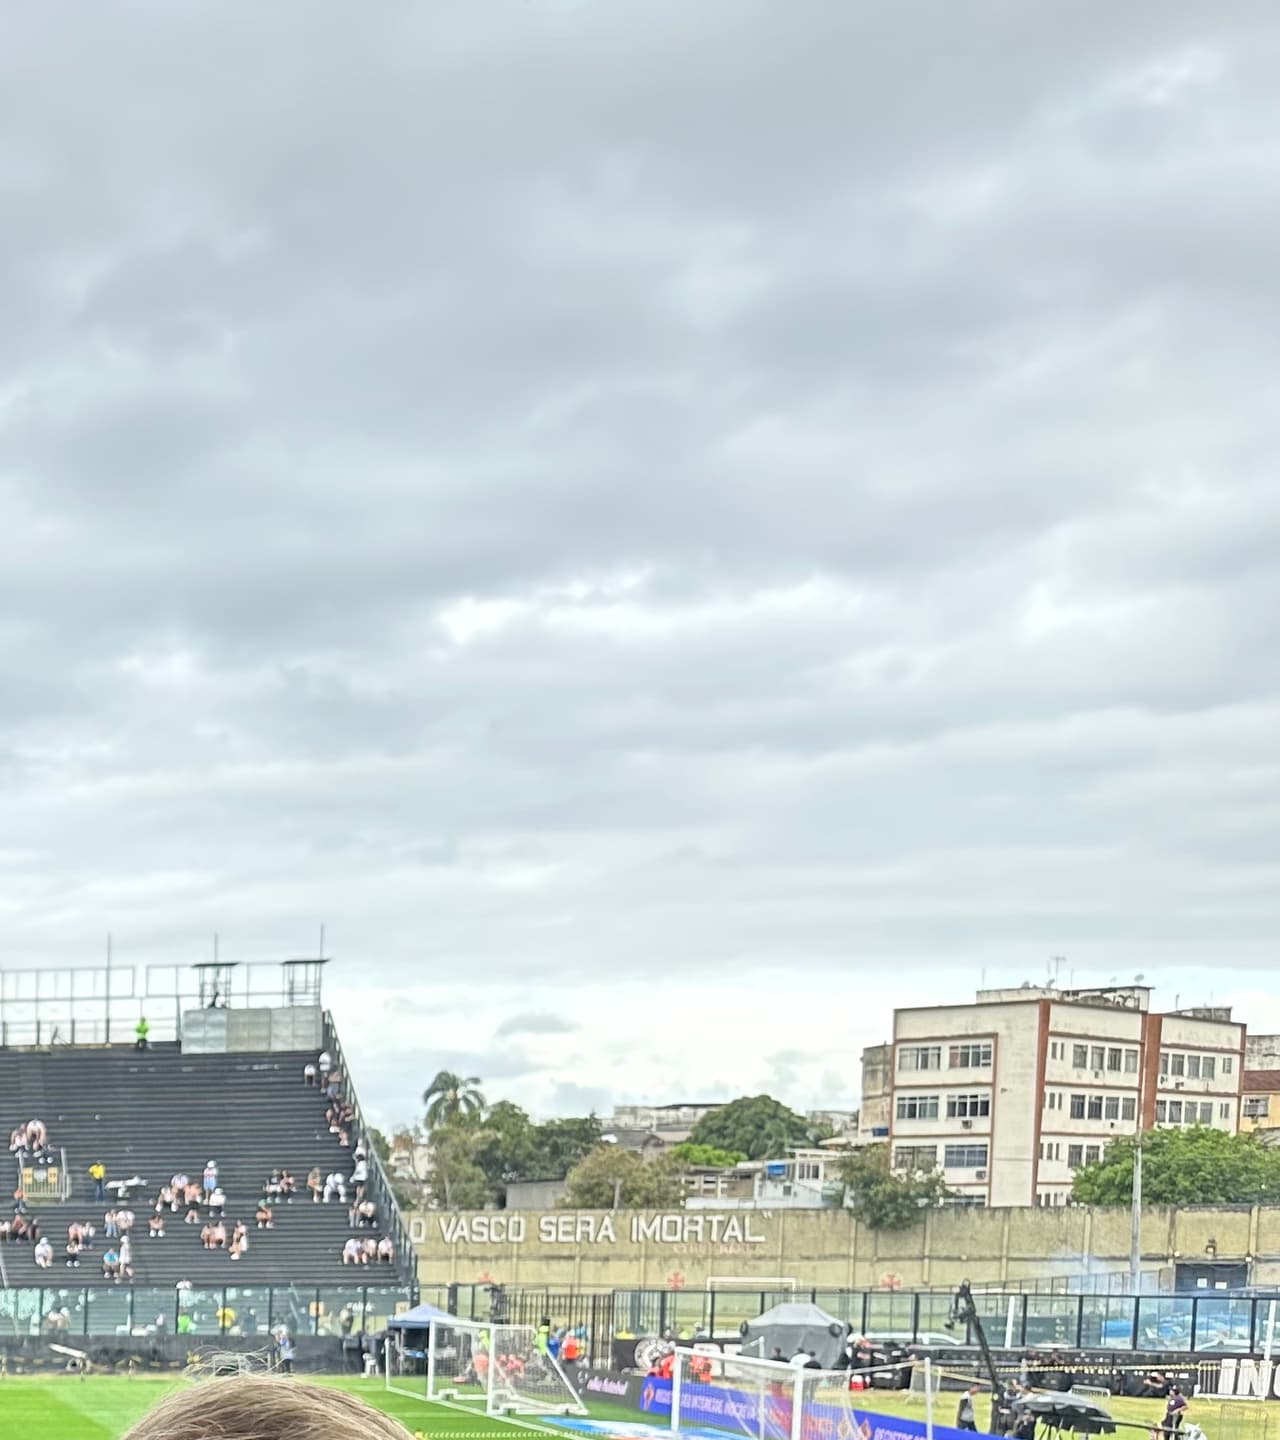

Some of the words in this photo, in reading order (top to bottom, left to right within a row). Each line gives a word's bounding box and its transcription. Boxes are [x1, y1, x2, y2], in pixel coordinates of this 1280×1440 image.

[439, 1215, 526, 1244] VASCO
[539, 1209, 617, 1244] SERÁ
[1217, 1358, 1280, 1399] IN
